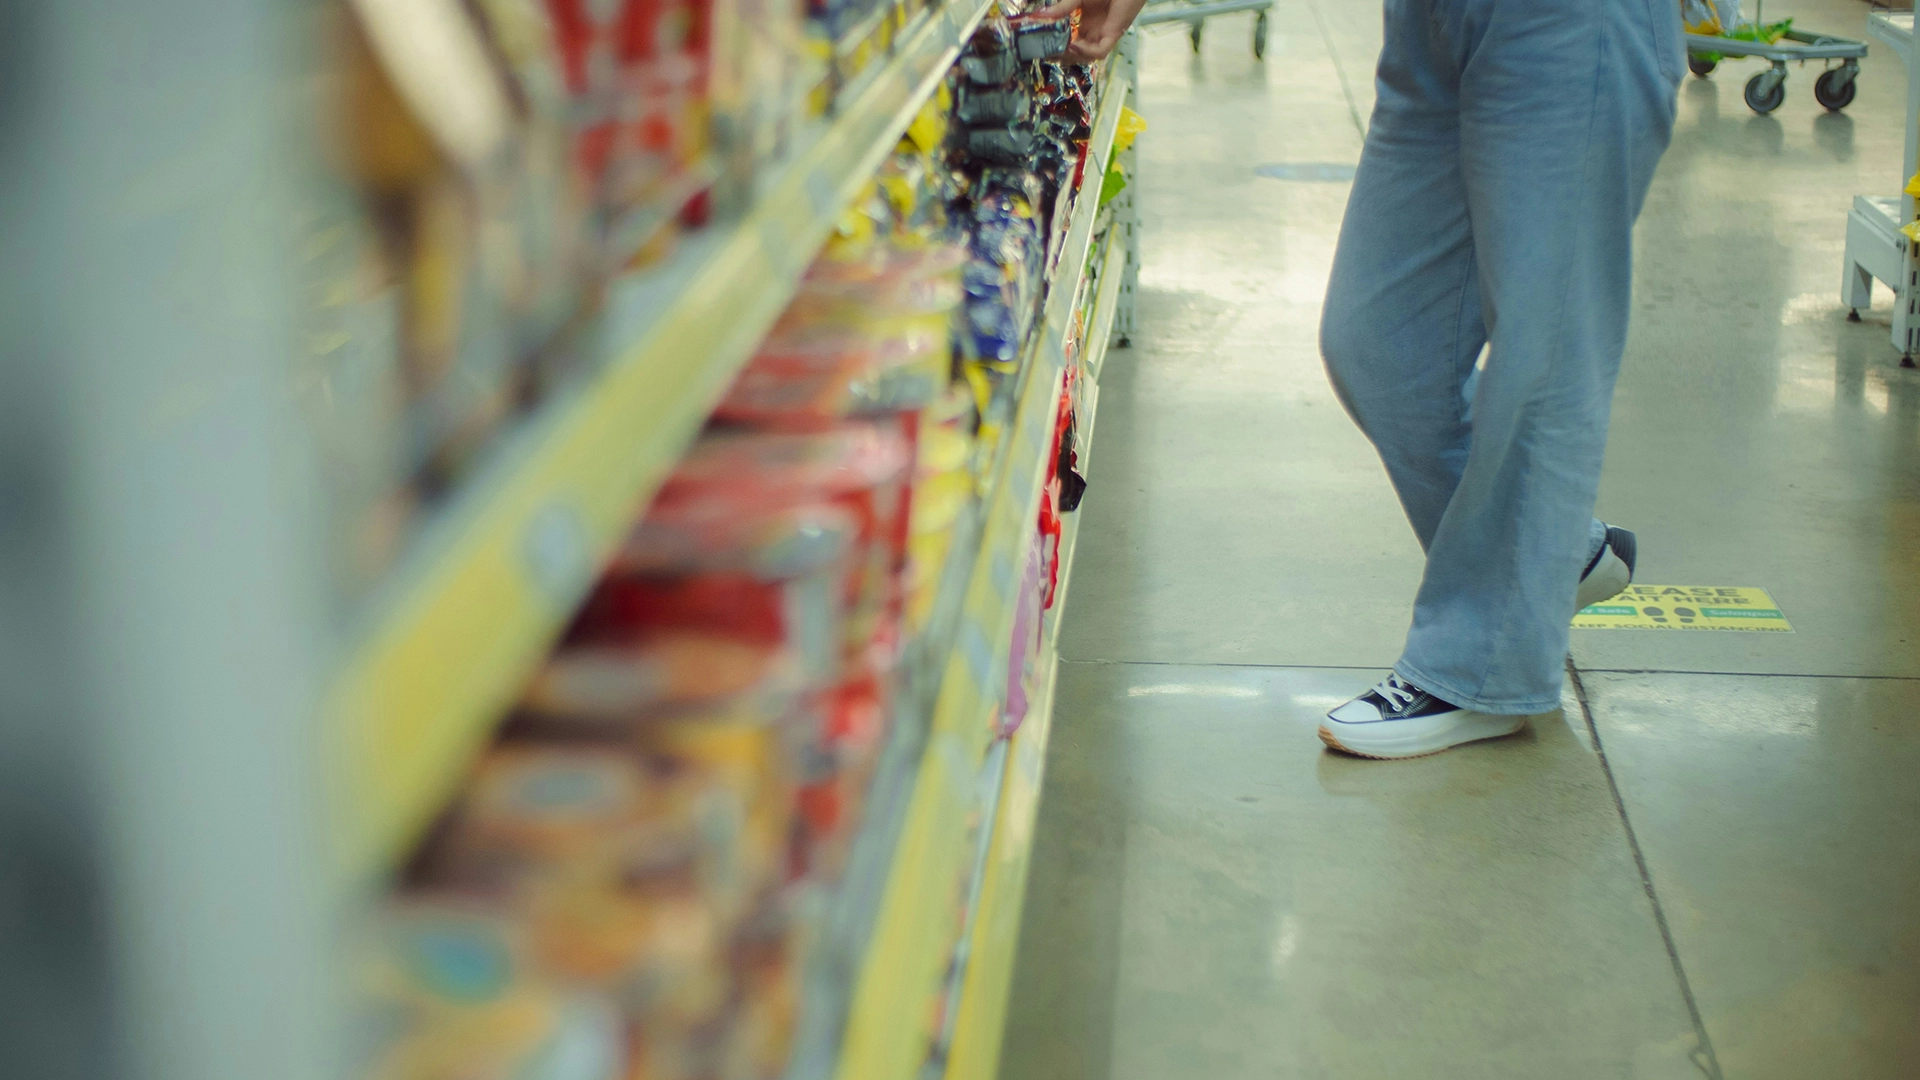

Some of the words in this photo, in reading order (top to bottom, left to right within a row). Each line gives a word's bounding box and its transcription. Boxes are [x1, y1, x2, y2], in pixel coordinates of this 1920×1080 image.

[1618, 586, 1741, 597] EASE
[1673, 596, 1751, 605] HERE
[1709, 609, 1778, 617] Salonpas
